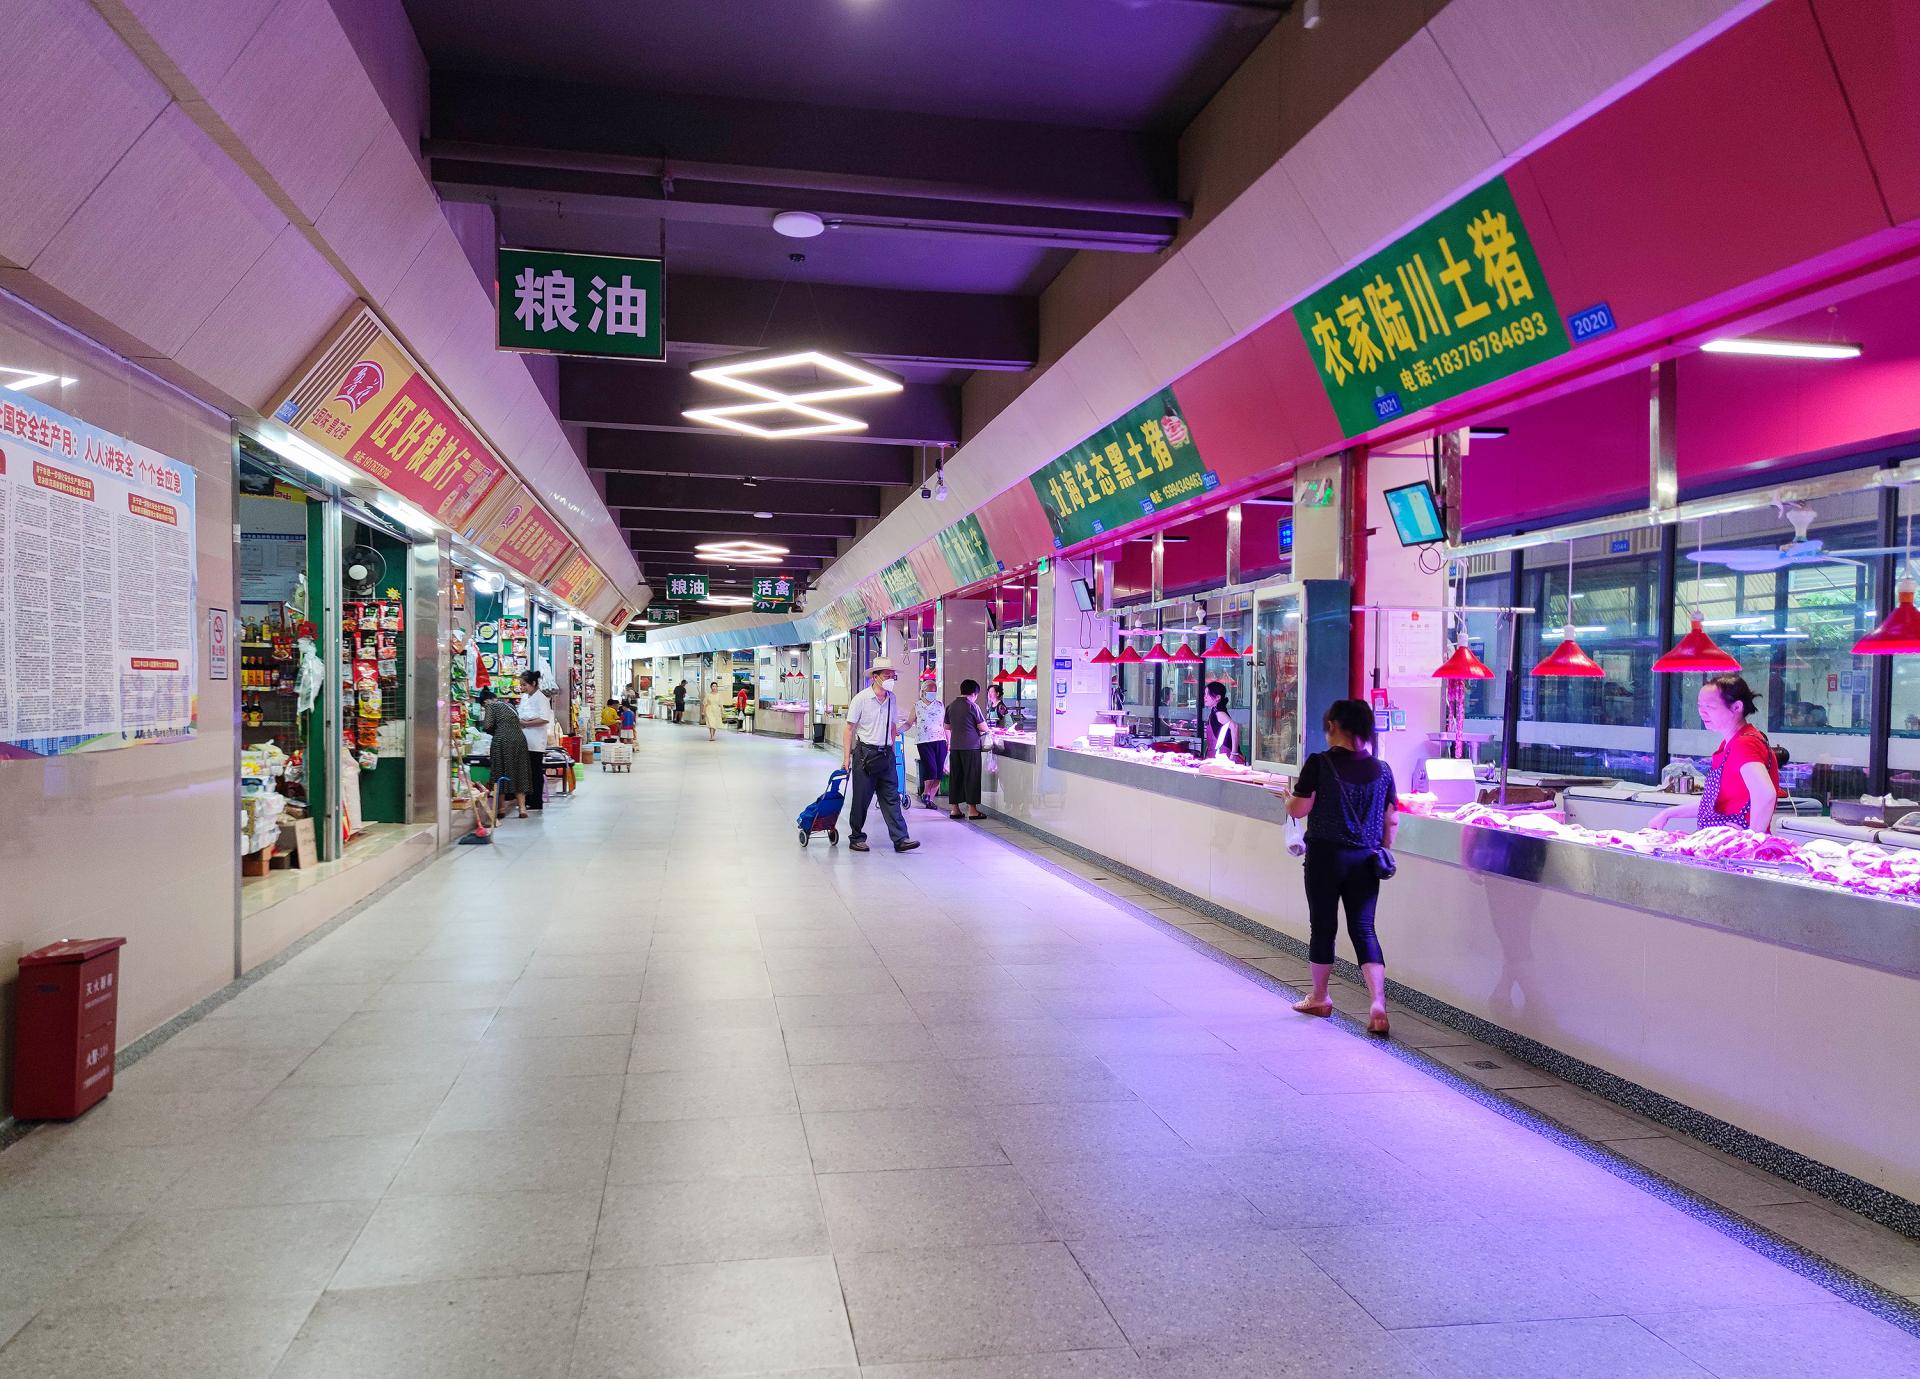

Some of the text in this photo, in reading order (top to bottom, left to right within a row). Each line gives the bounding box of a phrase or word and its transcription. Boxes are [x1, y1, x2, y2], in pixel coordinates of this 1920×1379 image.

[514, 267, 647, 338] 粮油
[1311, 208, 1535, 387] 农家陆川土猪
[1574, 310, 1609, 336] 2020
[1399, 311, 1549, 393] 电话:18376784693
[1377, 397, 1398, 417] 2021
[0, 403, 78, 457] 国安全生产月：
[84, 437, 135, 477] 人人讲安全
[138, 459, 182, 495] 个个会应急
[671, 578, 705, 595] 粮油
[757, 580, 791, 596] 活禽
[650, 608, 677, 621] 青菜
[627, 632, 646, 642] 水产
